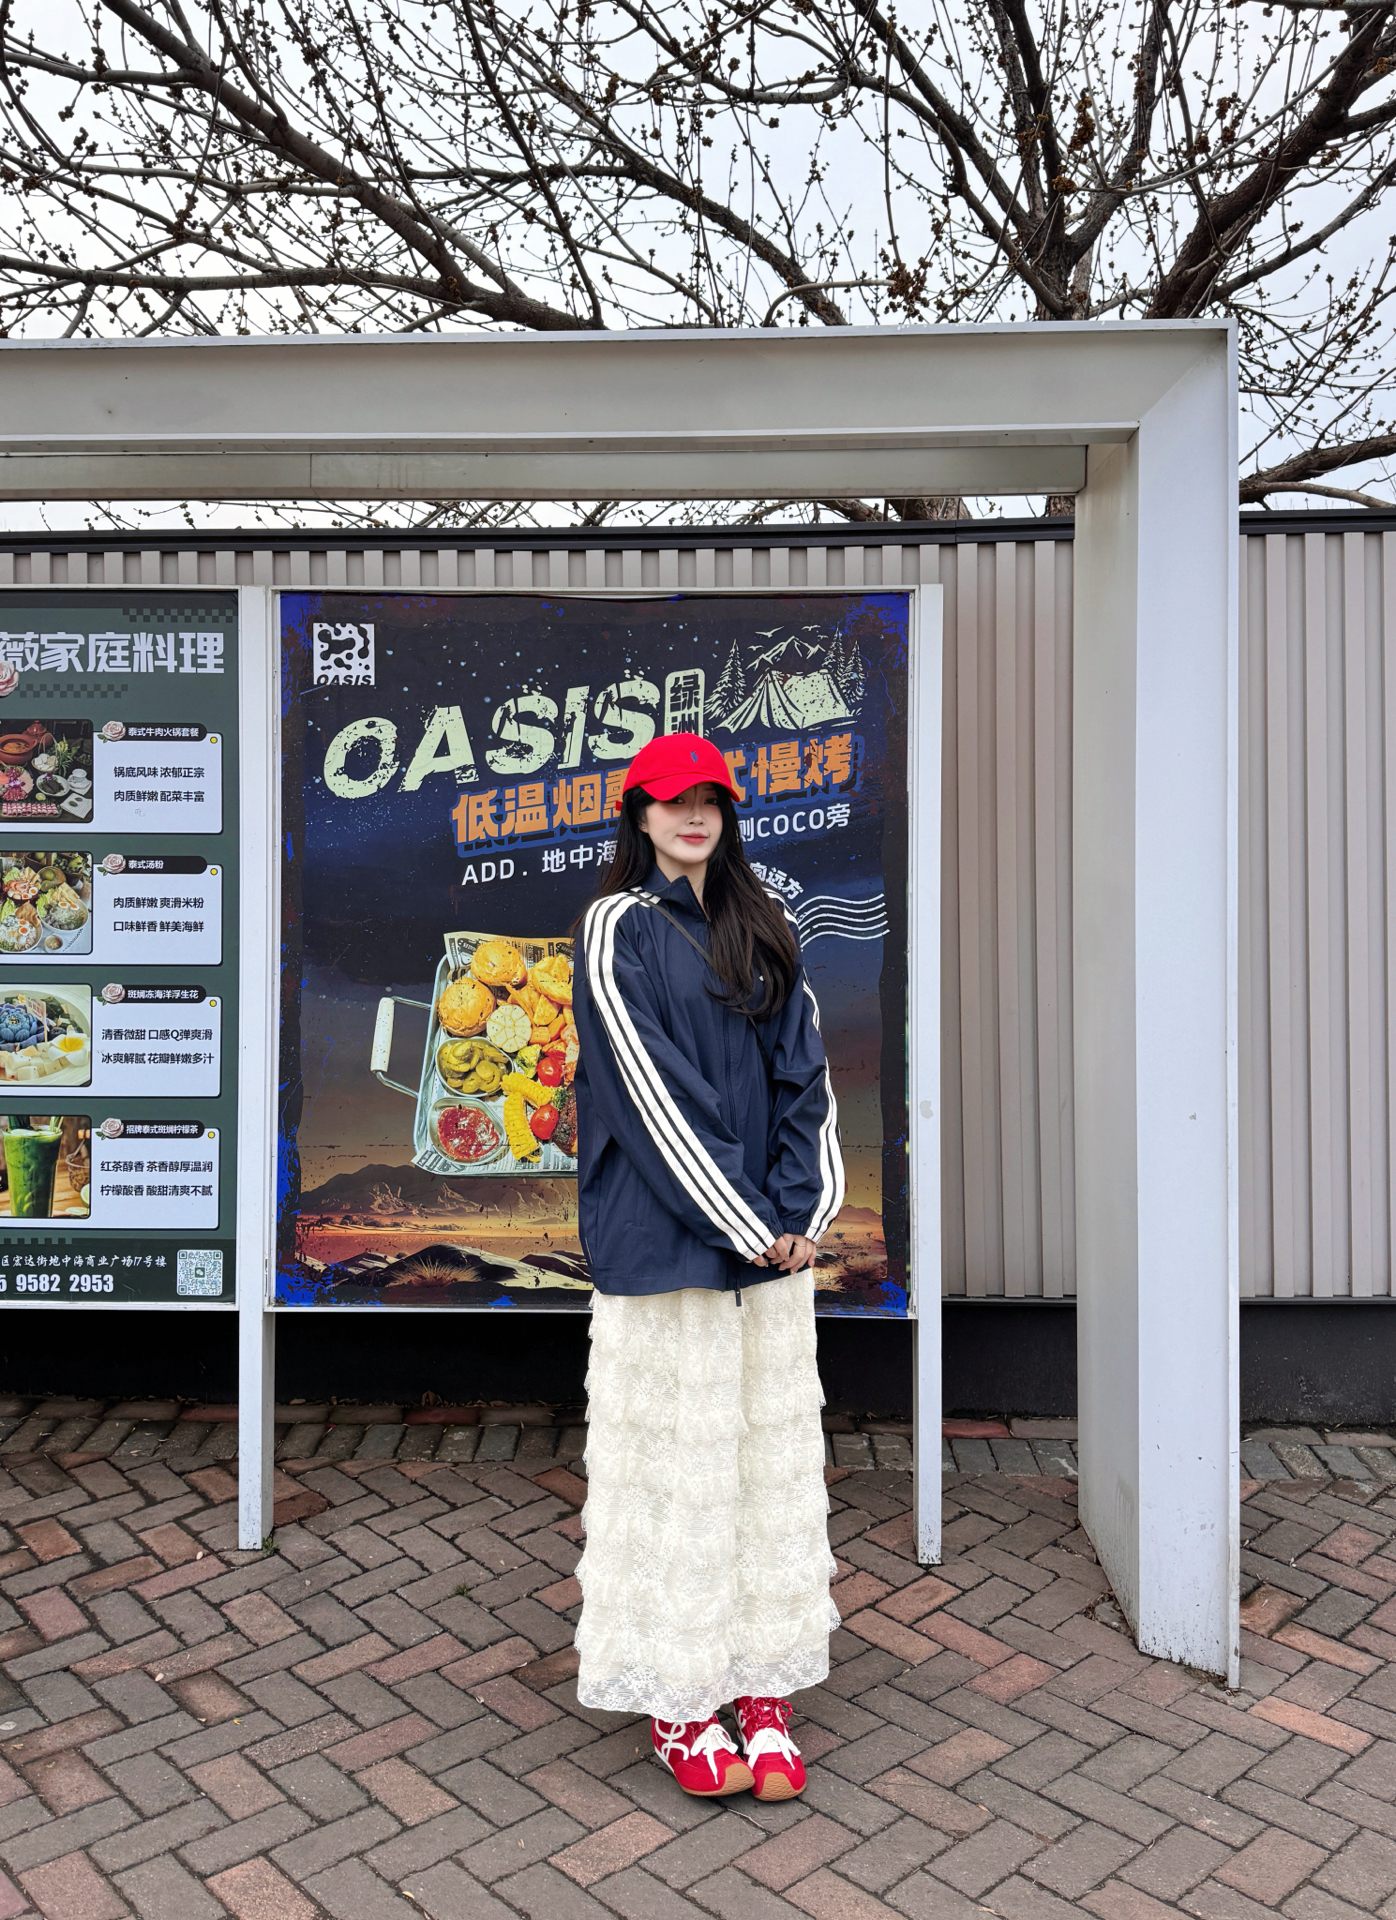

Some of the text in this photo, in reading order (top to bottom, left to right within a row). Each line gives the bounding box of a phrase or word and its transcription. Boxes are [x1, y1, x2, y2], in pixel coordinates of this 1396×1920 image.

[317, 674, 372, 686] OASIS
[128, 727, 199, 737] 泰式牛肉火锅套餐
[324, 679, 661, 799] OASIS
[114, 767, 204, 778] 锅底风味 浓郁正宗
[115, 790, 204, 802] 肉质鲜嫩 配菜丰富
[114, 897, 204, 908] 肉质鲜嫩 爽滑米粉
[114, 921, 204, 932] 口味鲜香 鲜美海鲜
[102, 1029, 212, 1041] 清香微甜 口感Q弹爽滑
[102, 1053, 214, 1064] 冰爽解腻 花瓣鲜嫩多汁
[101, 1161, 212, 1172] 红茶醇香 茶香醇厚温润
[101, 1185, 212, 1196] 柠檬酸香 酸甜清爽不腻
[16, 1273, 61, 1292] 9582
[69, 1274, 114, 1293] 2953
